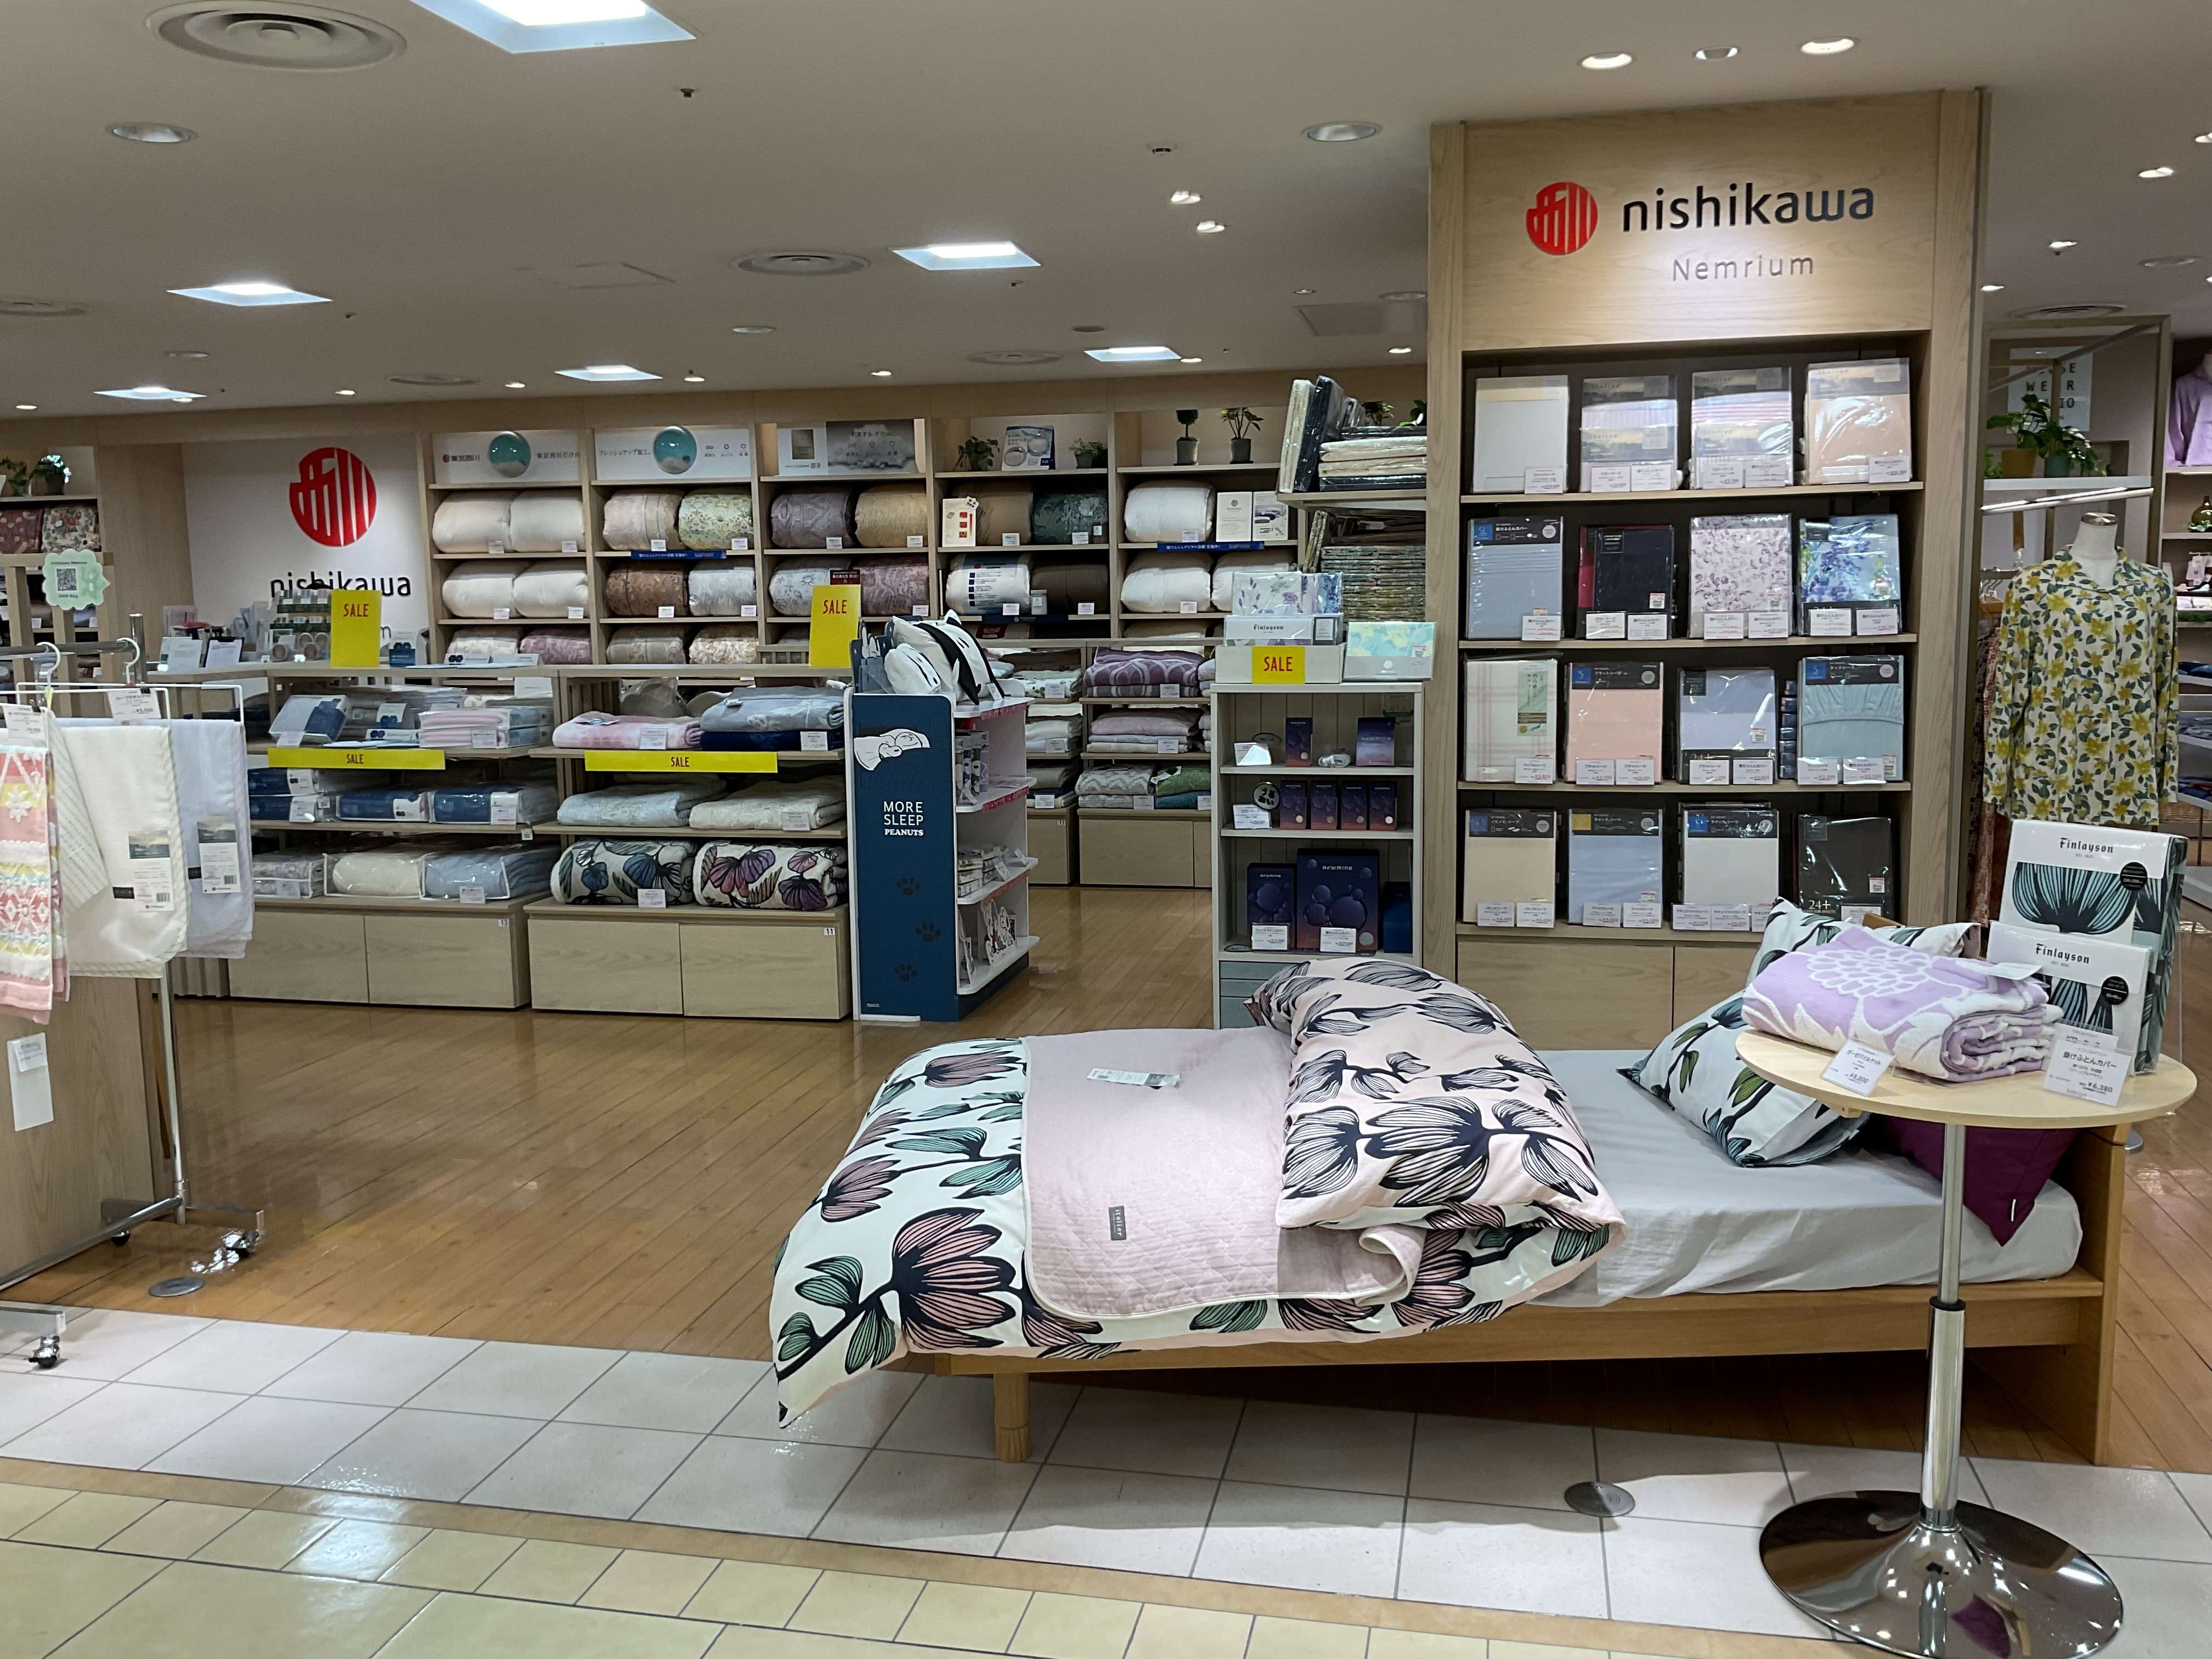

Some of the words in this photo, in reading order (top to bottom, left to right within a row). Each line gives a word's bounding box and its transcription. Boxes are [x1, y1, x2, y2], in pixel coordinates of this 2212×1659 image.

[1622, 182, 1874, 233] nishikawa
[1672, 254, 1814, 281] Nemrium
[343, 603, 369, 617] SALE
[823, 599, 848, 614] SALE
[1263, 656, 1293, 672] SALE
[346, 754, 364, 765] SALE
[670, 757, 690, 768] SALE
[883, 801, 923, 813] MORE
[884, 814, 923, 826] SLEEP
[2060, 837, 2113, 853] Finlayson
[1808, 900, 1831, 910] 24+
[2035, 943, 2090, 964] Finlayson
[2063, 1051, 2118, 1069] 掛けふとんカバー
